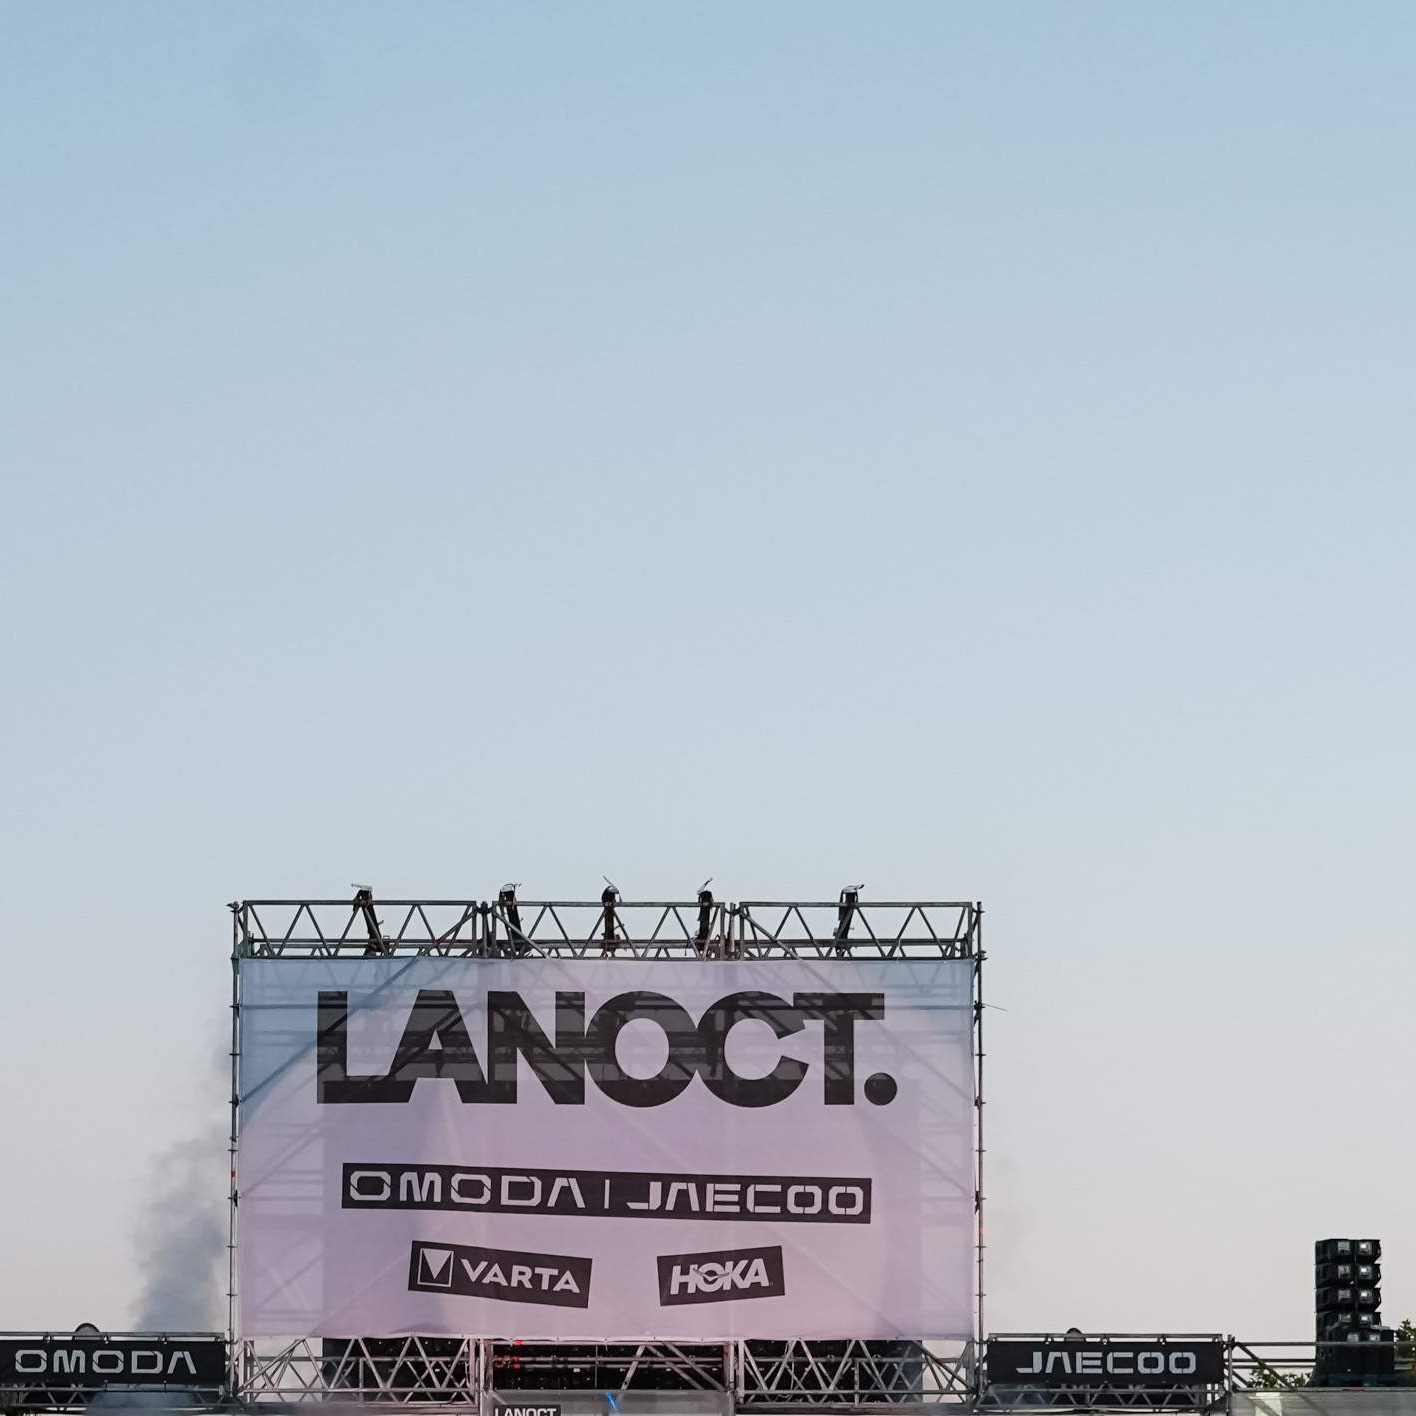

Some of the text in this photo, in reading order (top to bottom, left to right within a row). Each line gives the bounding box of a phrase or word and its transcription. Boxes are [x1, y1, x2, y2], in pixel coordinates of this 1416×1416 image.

[317, 990, 897, 1108] LANOCT.
[349, 1170, 865, 1216] OMODA JAECOO
[461, 1258, 581, 1295] VARTA
[669, 1257, 771, 1295] HOKA
[14, 1349, 198, 1374] OMODA
[1016, 1350, 1197, 1374] JAECOO
